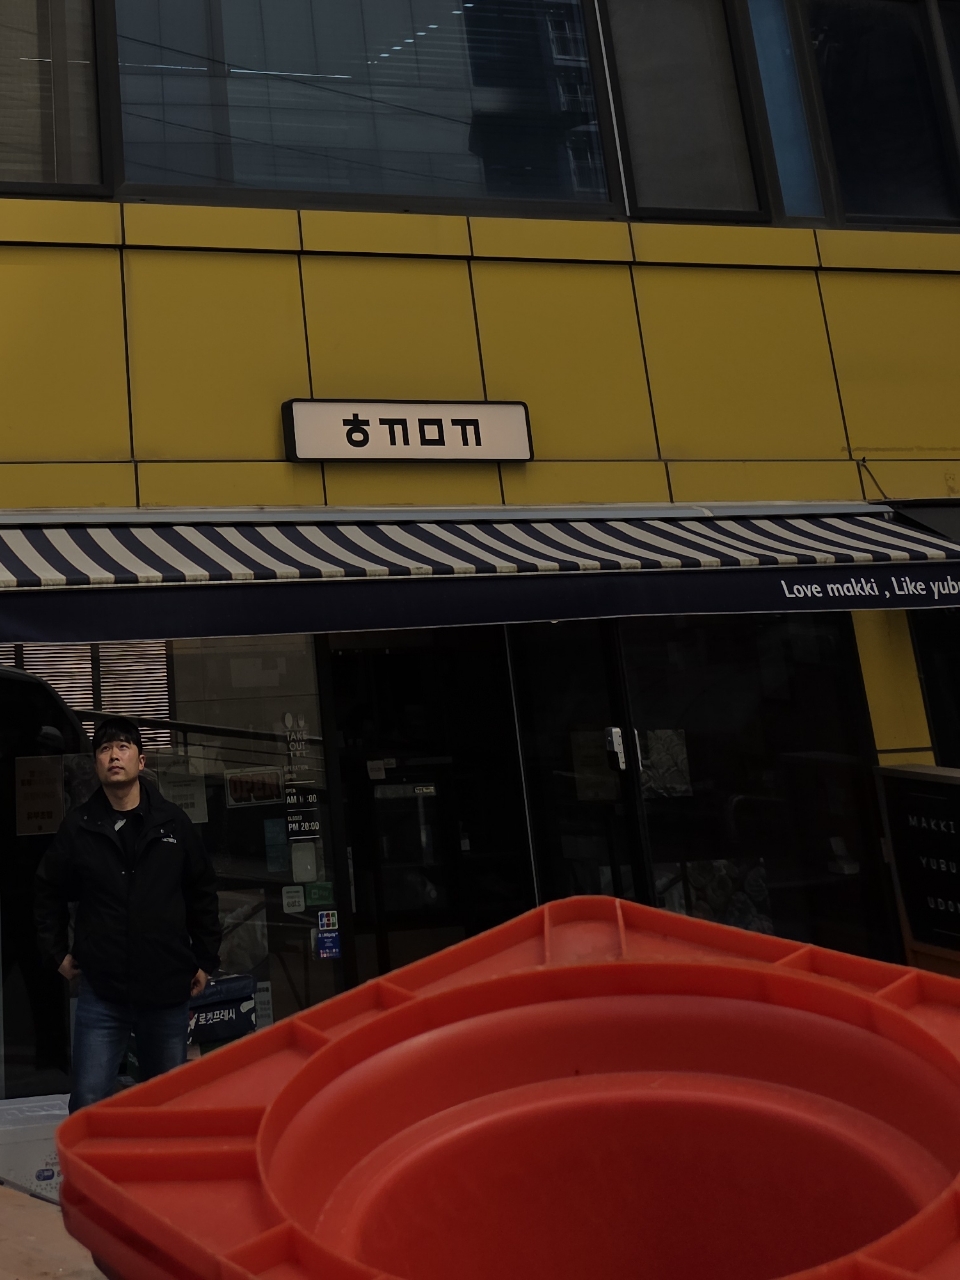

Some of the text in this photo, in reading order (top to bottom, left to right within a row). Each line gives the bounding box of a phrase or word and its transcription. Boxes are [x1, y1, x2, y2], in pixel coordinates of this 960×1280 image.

[781, 579, 823, 598] Love
[827, 577, 880, 597] makki
[891, 576, 927, 596] Like
[286, 731, 308, 741] TAKE
[289, 741, 305, 751] OUT
[228, 771, 282, 803] OPEN
[286, 795, 297, 805] AM
[288, 822, 299, 832] PM
[907, 814, 956, 834] MAKKI
[919, 856, 957, 873] YUBU
[198, 1008, 236, 1025] 로켓프레시
